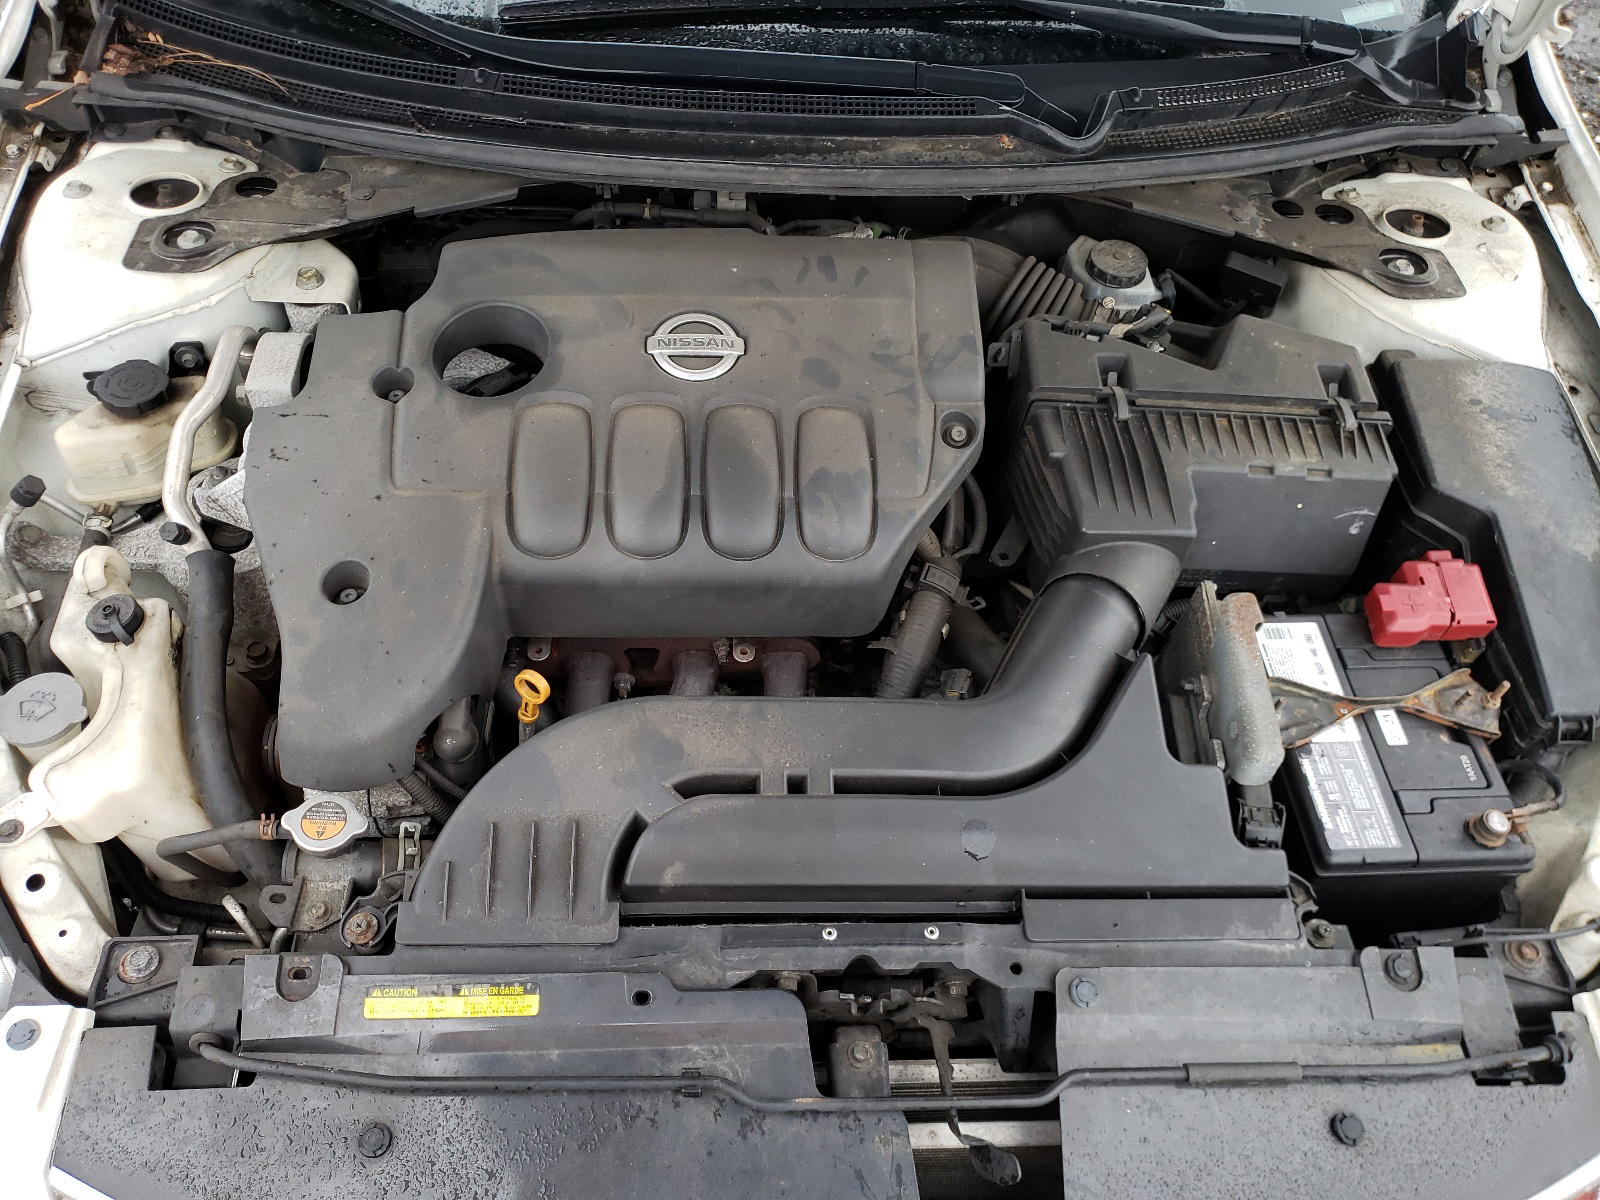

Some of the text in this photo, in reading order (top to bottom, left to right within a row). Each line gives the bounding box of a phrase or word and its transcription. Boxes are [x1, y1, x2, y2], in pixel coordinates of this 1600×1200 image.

[657, 337, 735, 349] NISSAN
[383, 988, 418, 997] CAUTION
[470, 986, 524, 995] MISE EN GARDE
